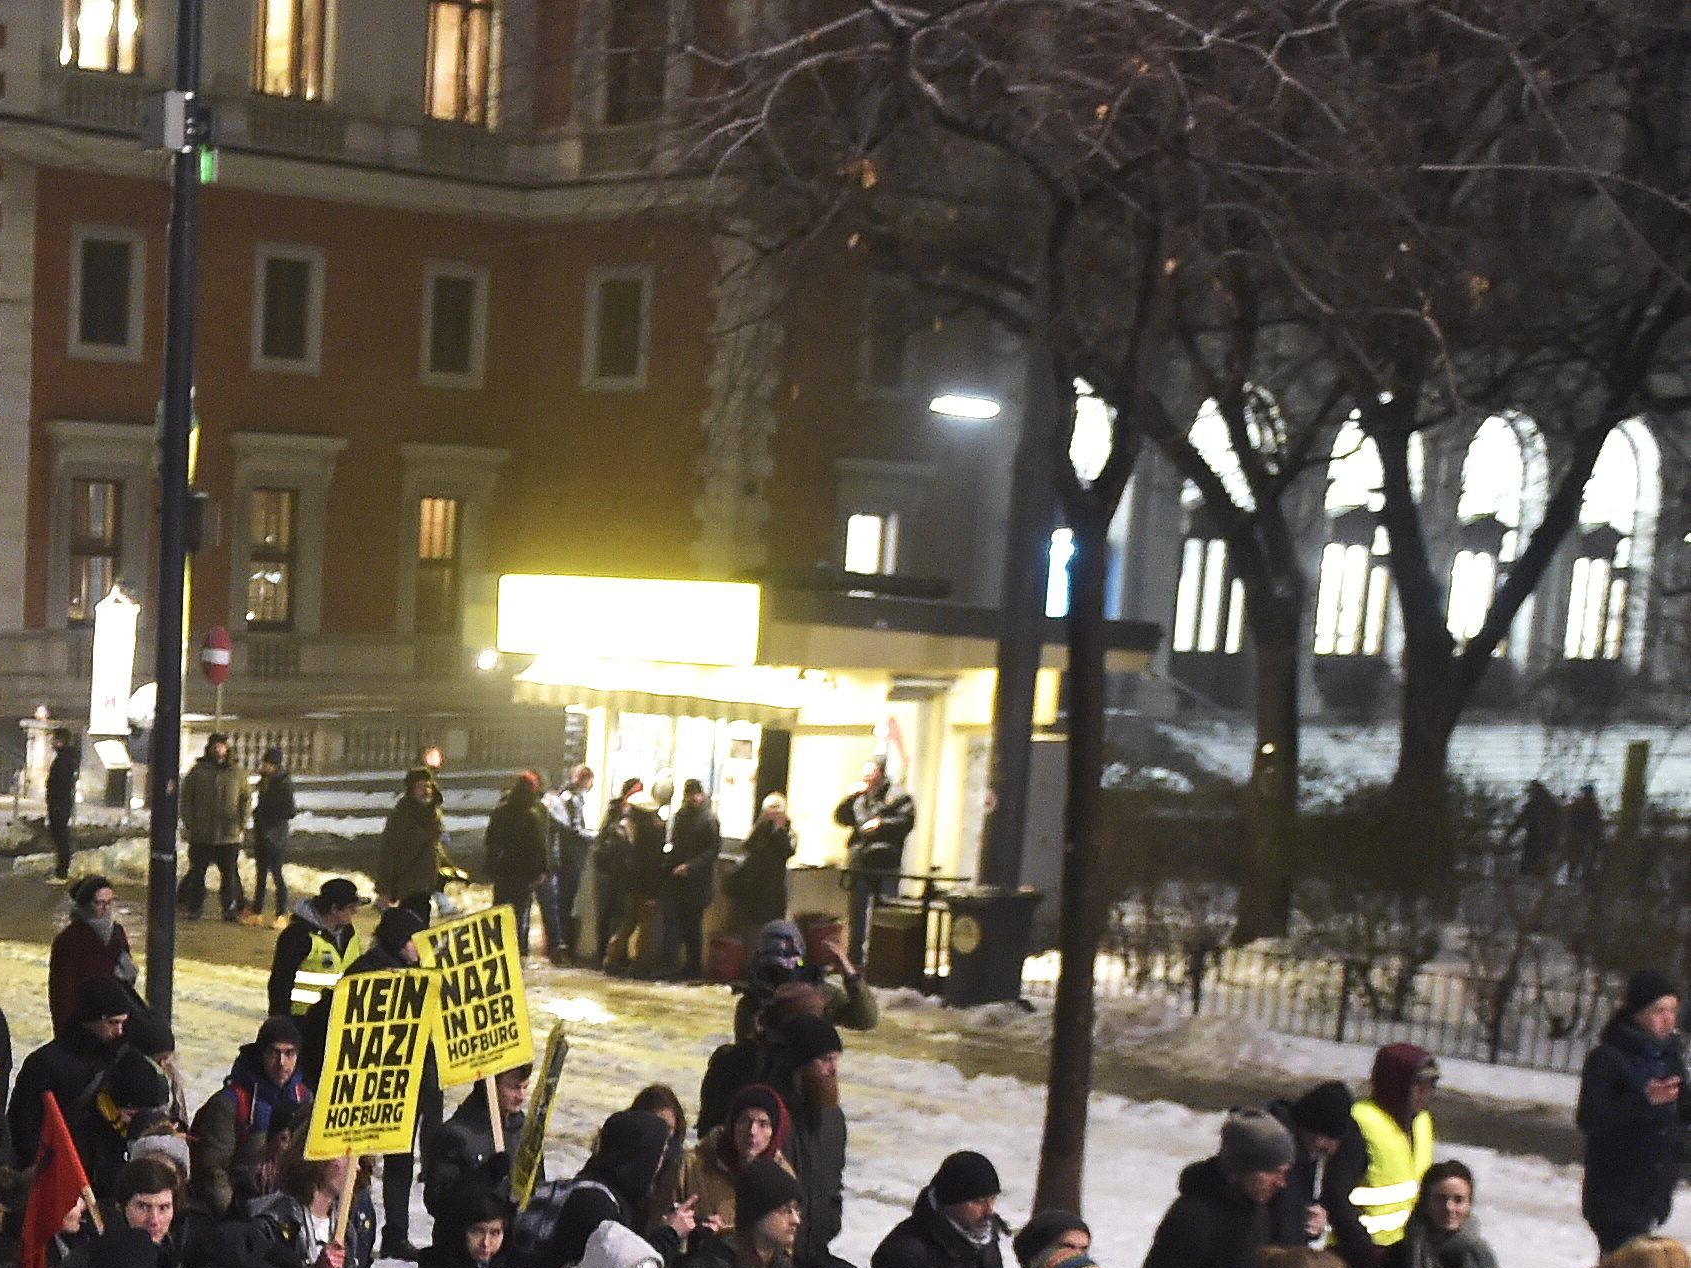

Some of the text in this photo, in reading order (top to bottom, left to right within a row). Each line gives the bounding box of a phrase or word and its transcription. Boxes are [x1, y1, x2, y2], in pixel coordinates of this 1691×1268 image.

[428, 914, 504, 969] KEIN
[343, 975, 430, 1024] KEIN
[440, 955, 511, 1011] NAZI
[442, 994, 515, 1040] IN DER
[335, 1023, 420, 1072] NAZI
[446, 1022, 519, 1062] HOFBURG
[329, 1069, 410, 1104] IN DER
[324, 1102, 404, 1130] HOFBURG
